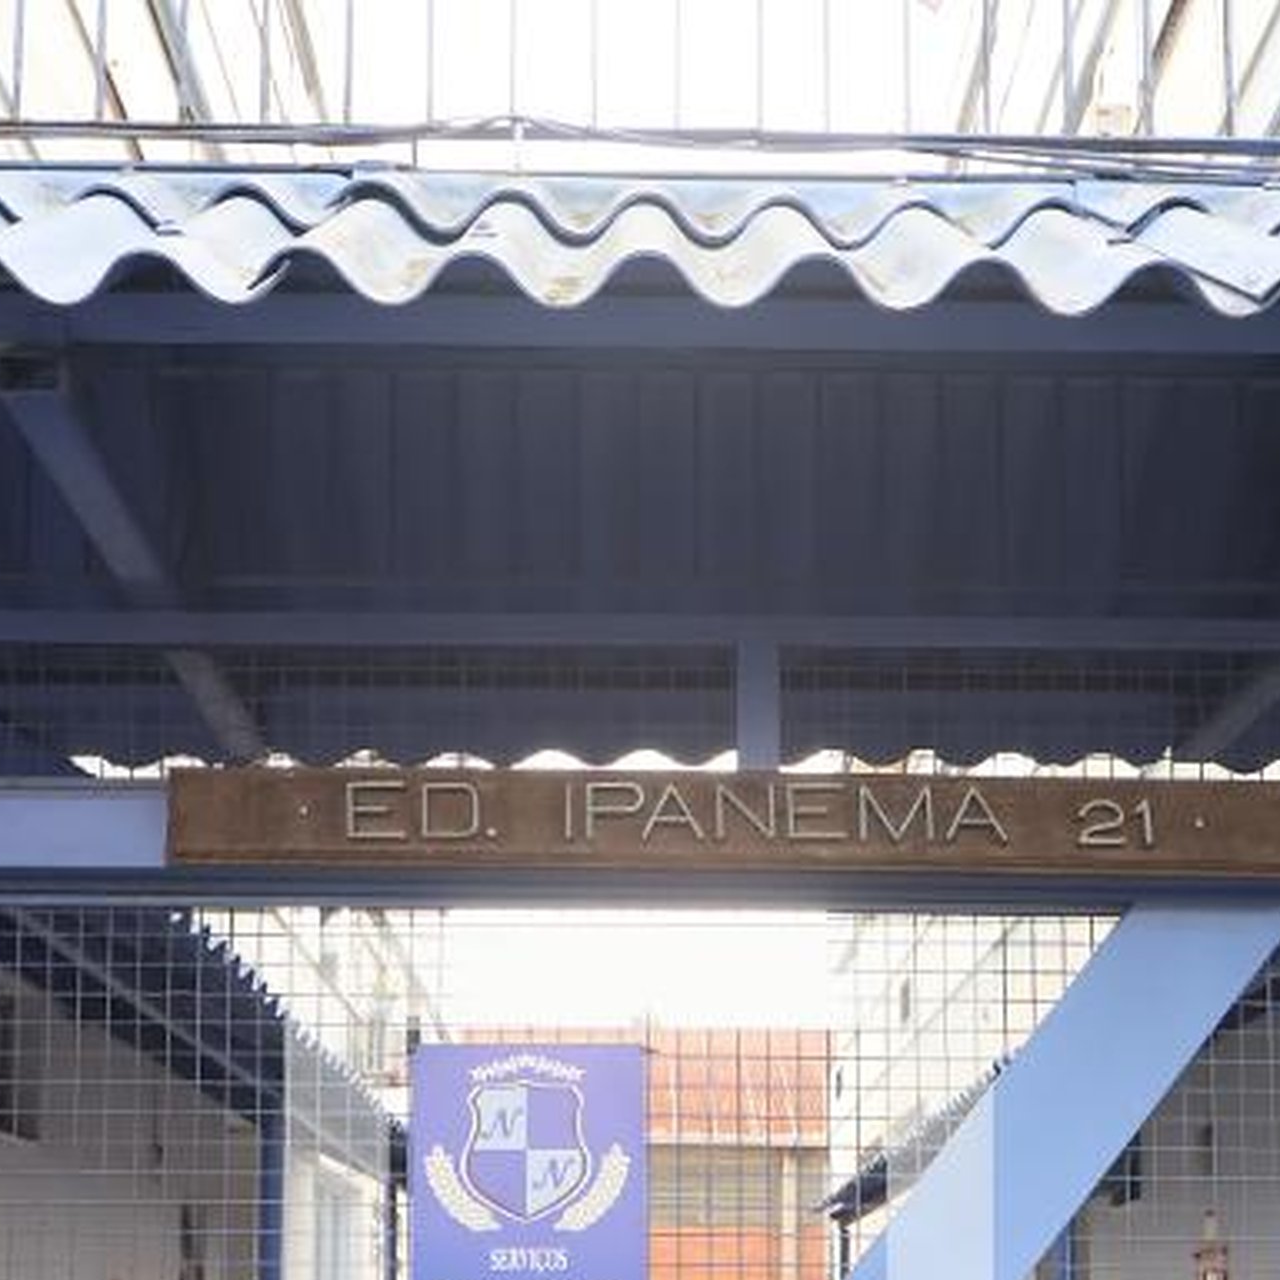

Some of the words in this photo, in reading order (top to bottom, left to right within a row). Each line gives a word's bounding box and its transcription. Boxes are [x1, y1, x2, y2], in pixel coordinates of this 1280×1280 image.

[345, 781, 499, 841] ED.
[564, 780, 1010, 845] IPANEMA
[1077, 799, 1156, 850] 21
